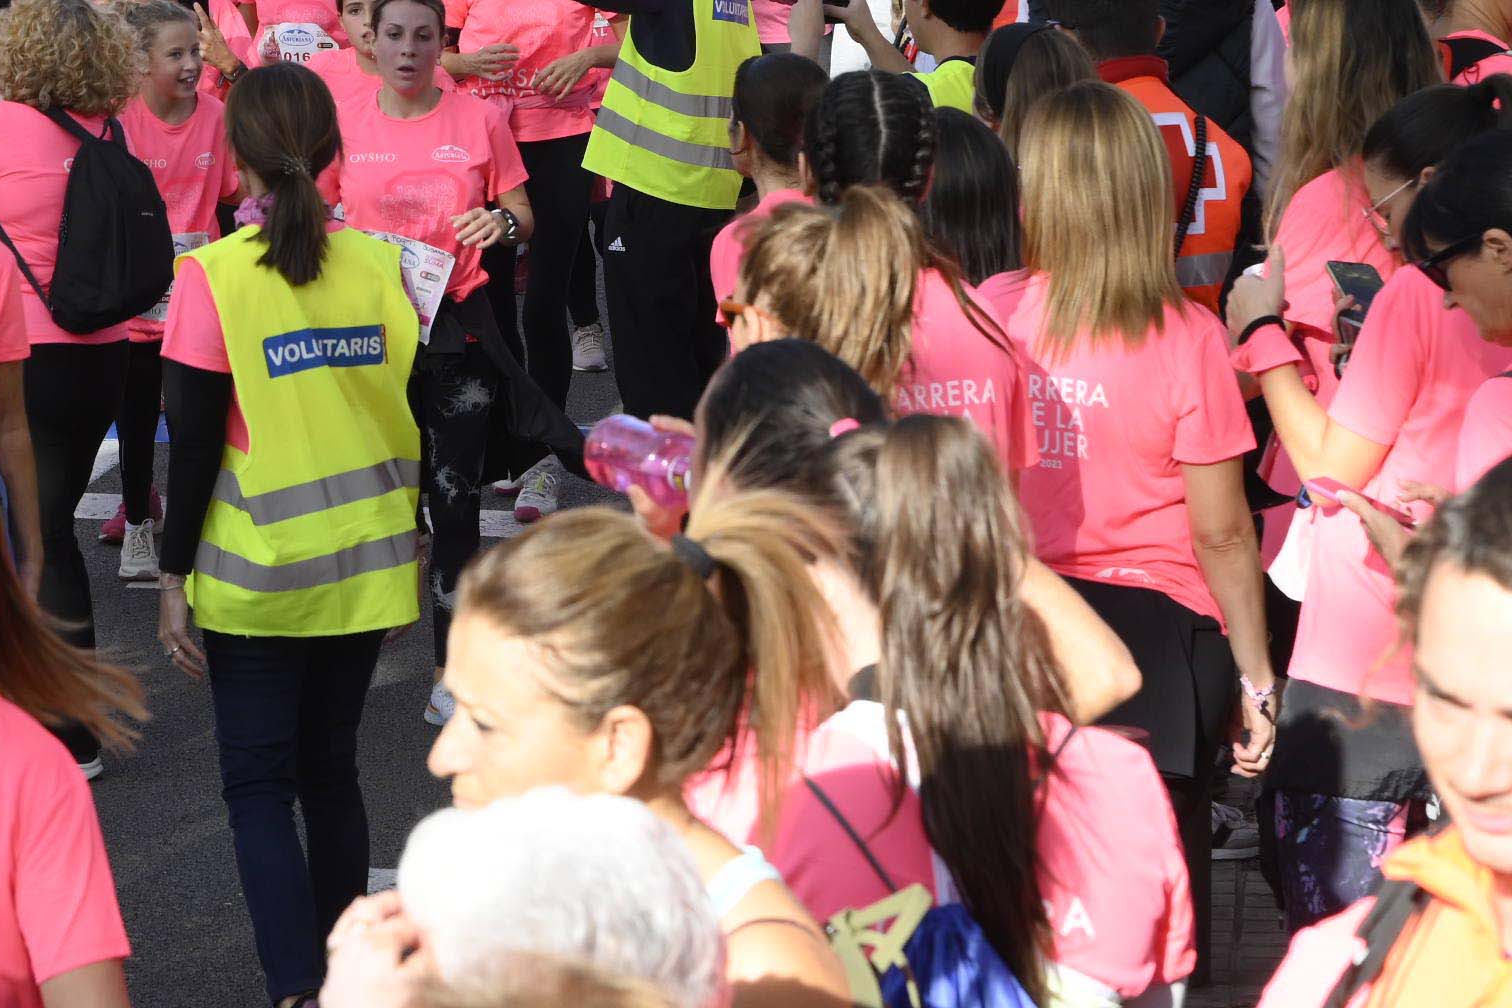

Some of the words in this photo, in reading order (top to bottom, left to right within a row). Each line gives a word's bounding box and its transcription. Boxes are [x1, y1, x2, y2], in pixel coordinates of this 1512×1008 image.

[281, 33, 312, 43] ASTURIANA
[283, 50, 311, 62] 016
[349, 153, 396, 163] OYSHO
[1056, 405, 1085, 432] LA
